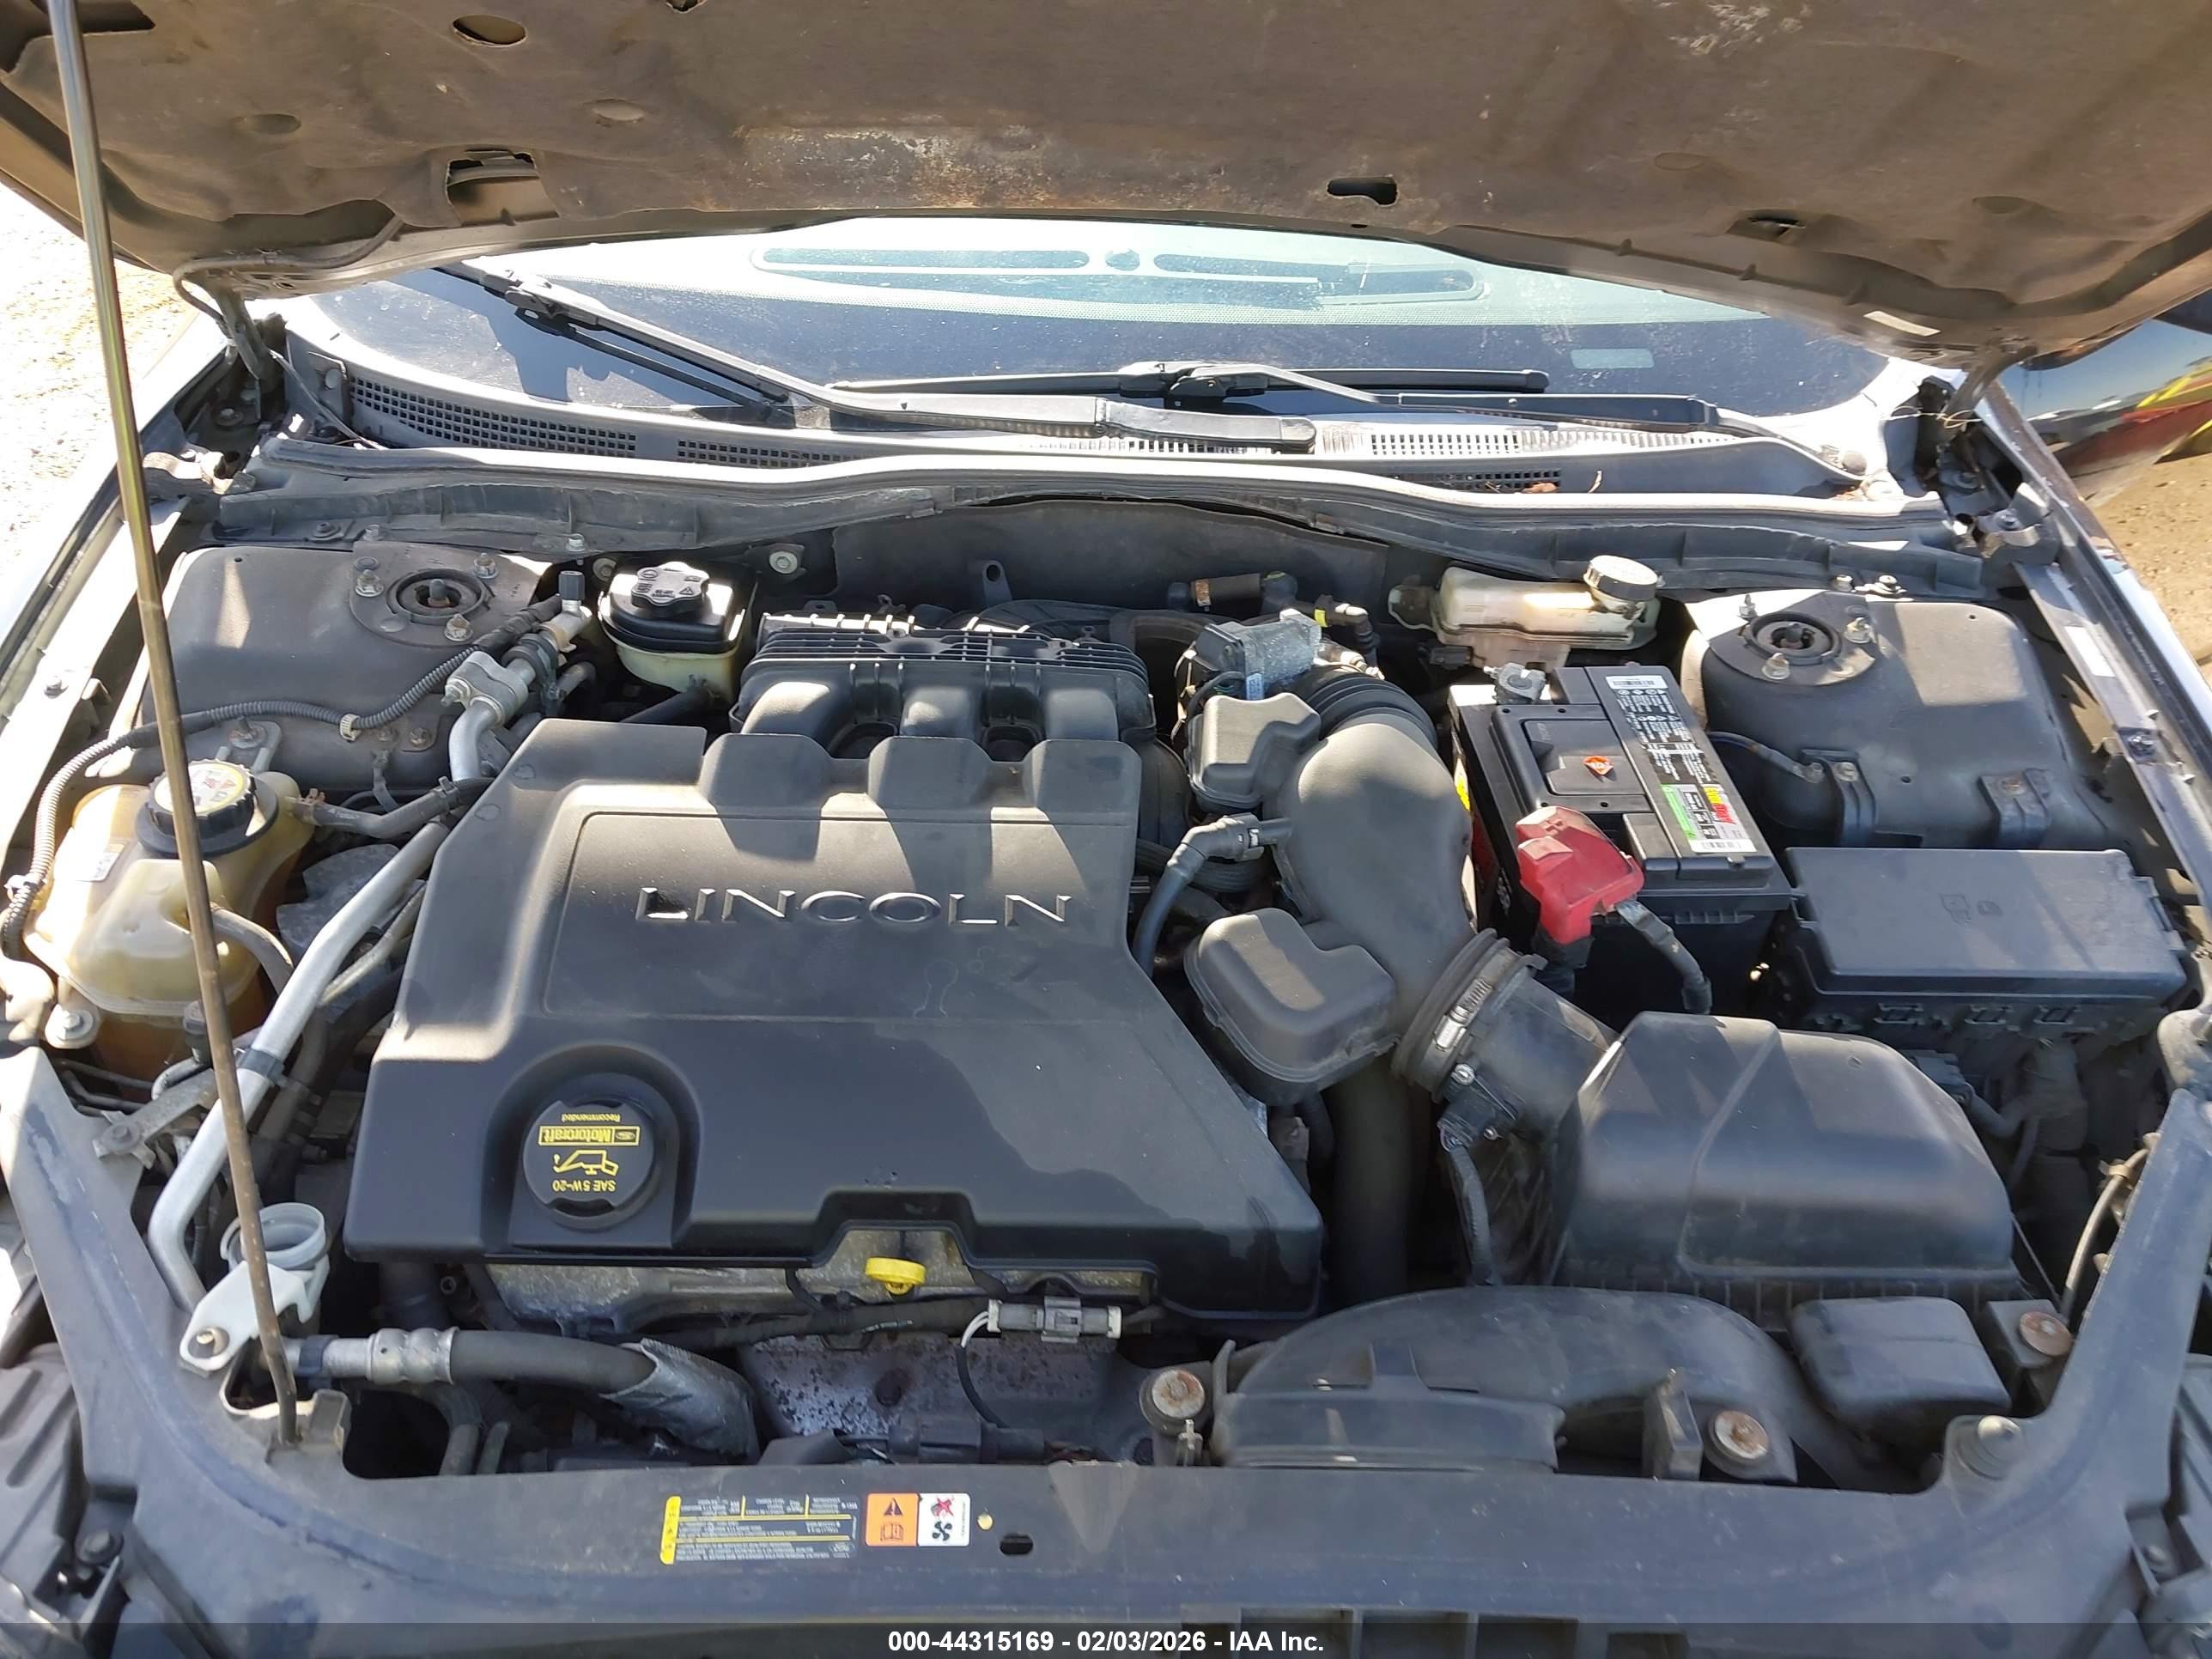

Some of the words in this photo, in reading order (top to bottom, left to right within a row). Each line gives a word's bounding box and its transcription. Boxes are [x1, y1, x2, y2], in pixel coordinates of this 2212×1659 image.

[635, 887, 1073, 927] LINCOLN
[544, 1128, 611, 1144] Motorcraft
[552, 1179, 592, 1192] 5W-20
[592, 1179, 617, 1192] SAE
